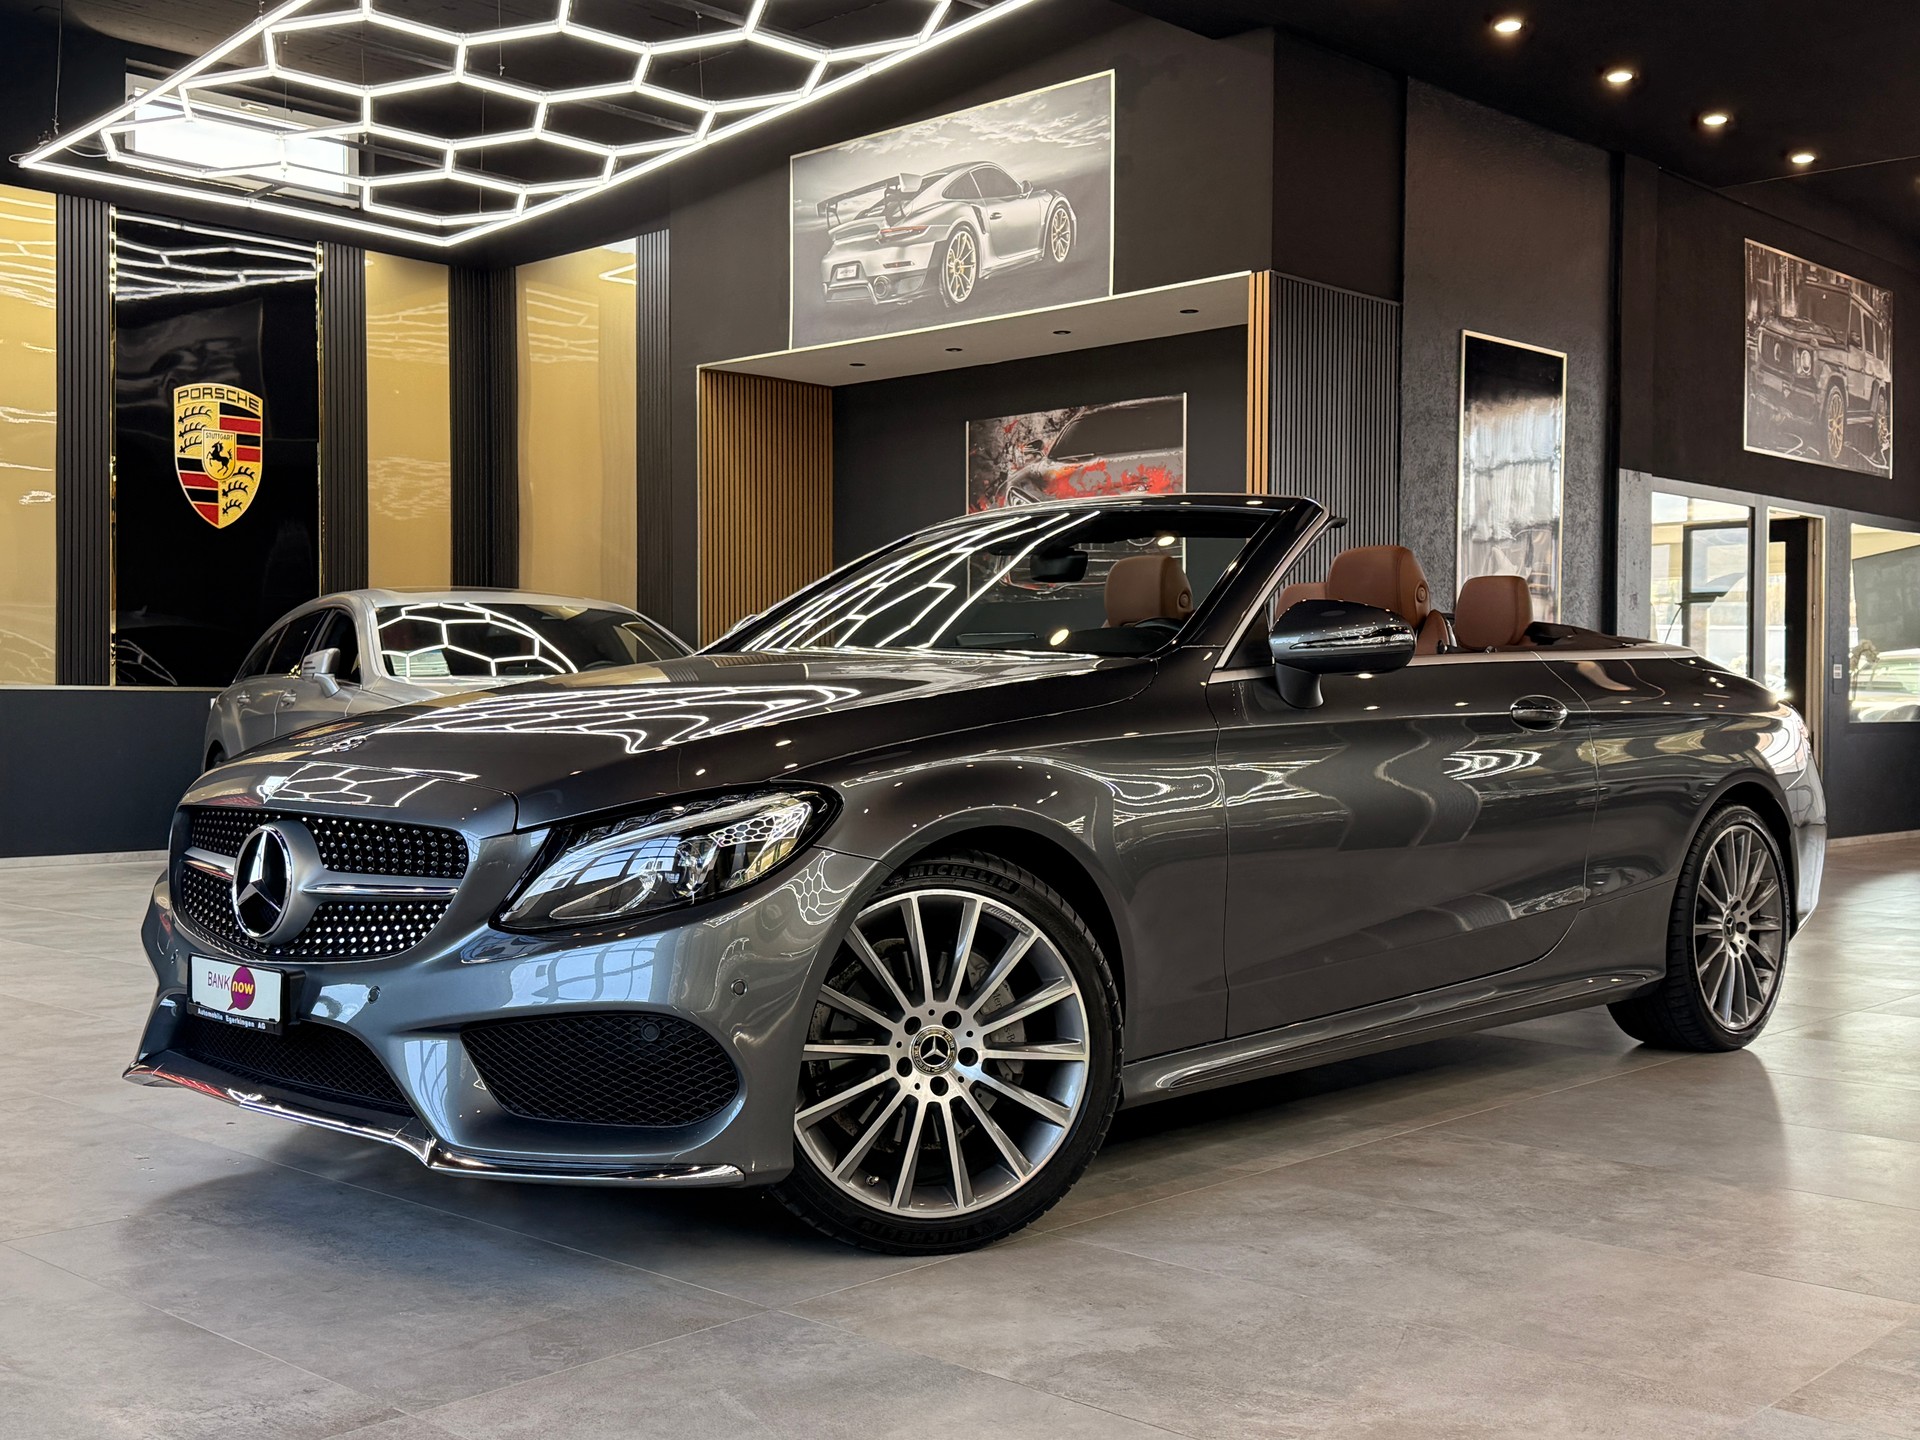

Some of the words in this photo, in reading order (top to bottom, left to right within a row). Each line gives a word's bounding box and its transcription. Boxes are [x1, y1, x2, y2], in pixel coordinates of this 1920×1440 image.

[177, 387, 260, 413] PORSCHE
[205, 432, 234, 441] STUTTGART
[908, 864, 1013, 890] MICHELIN
[208, 971, 231, 991] BANK
[232, 980, 254, 995] now
[197, 1007, 224, 1021] Automobile
[225, 1014, 255, 1028] Egerkingen
[257, 1022, 266, 1030] AG
